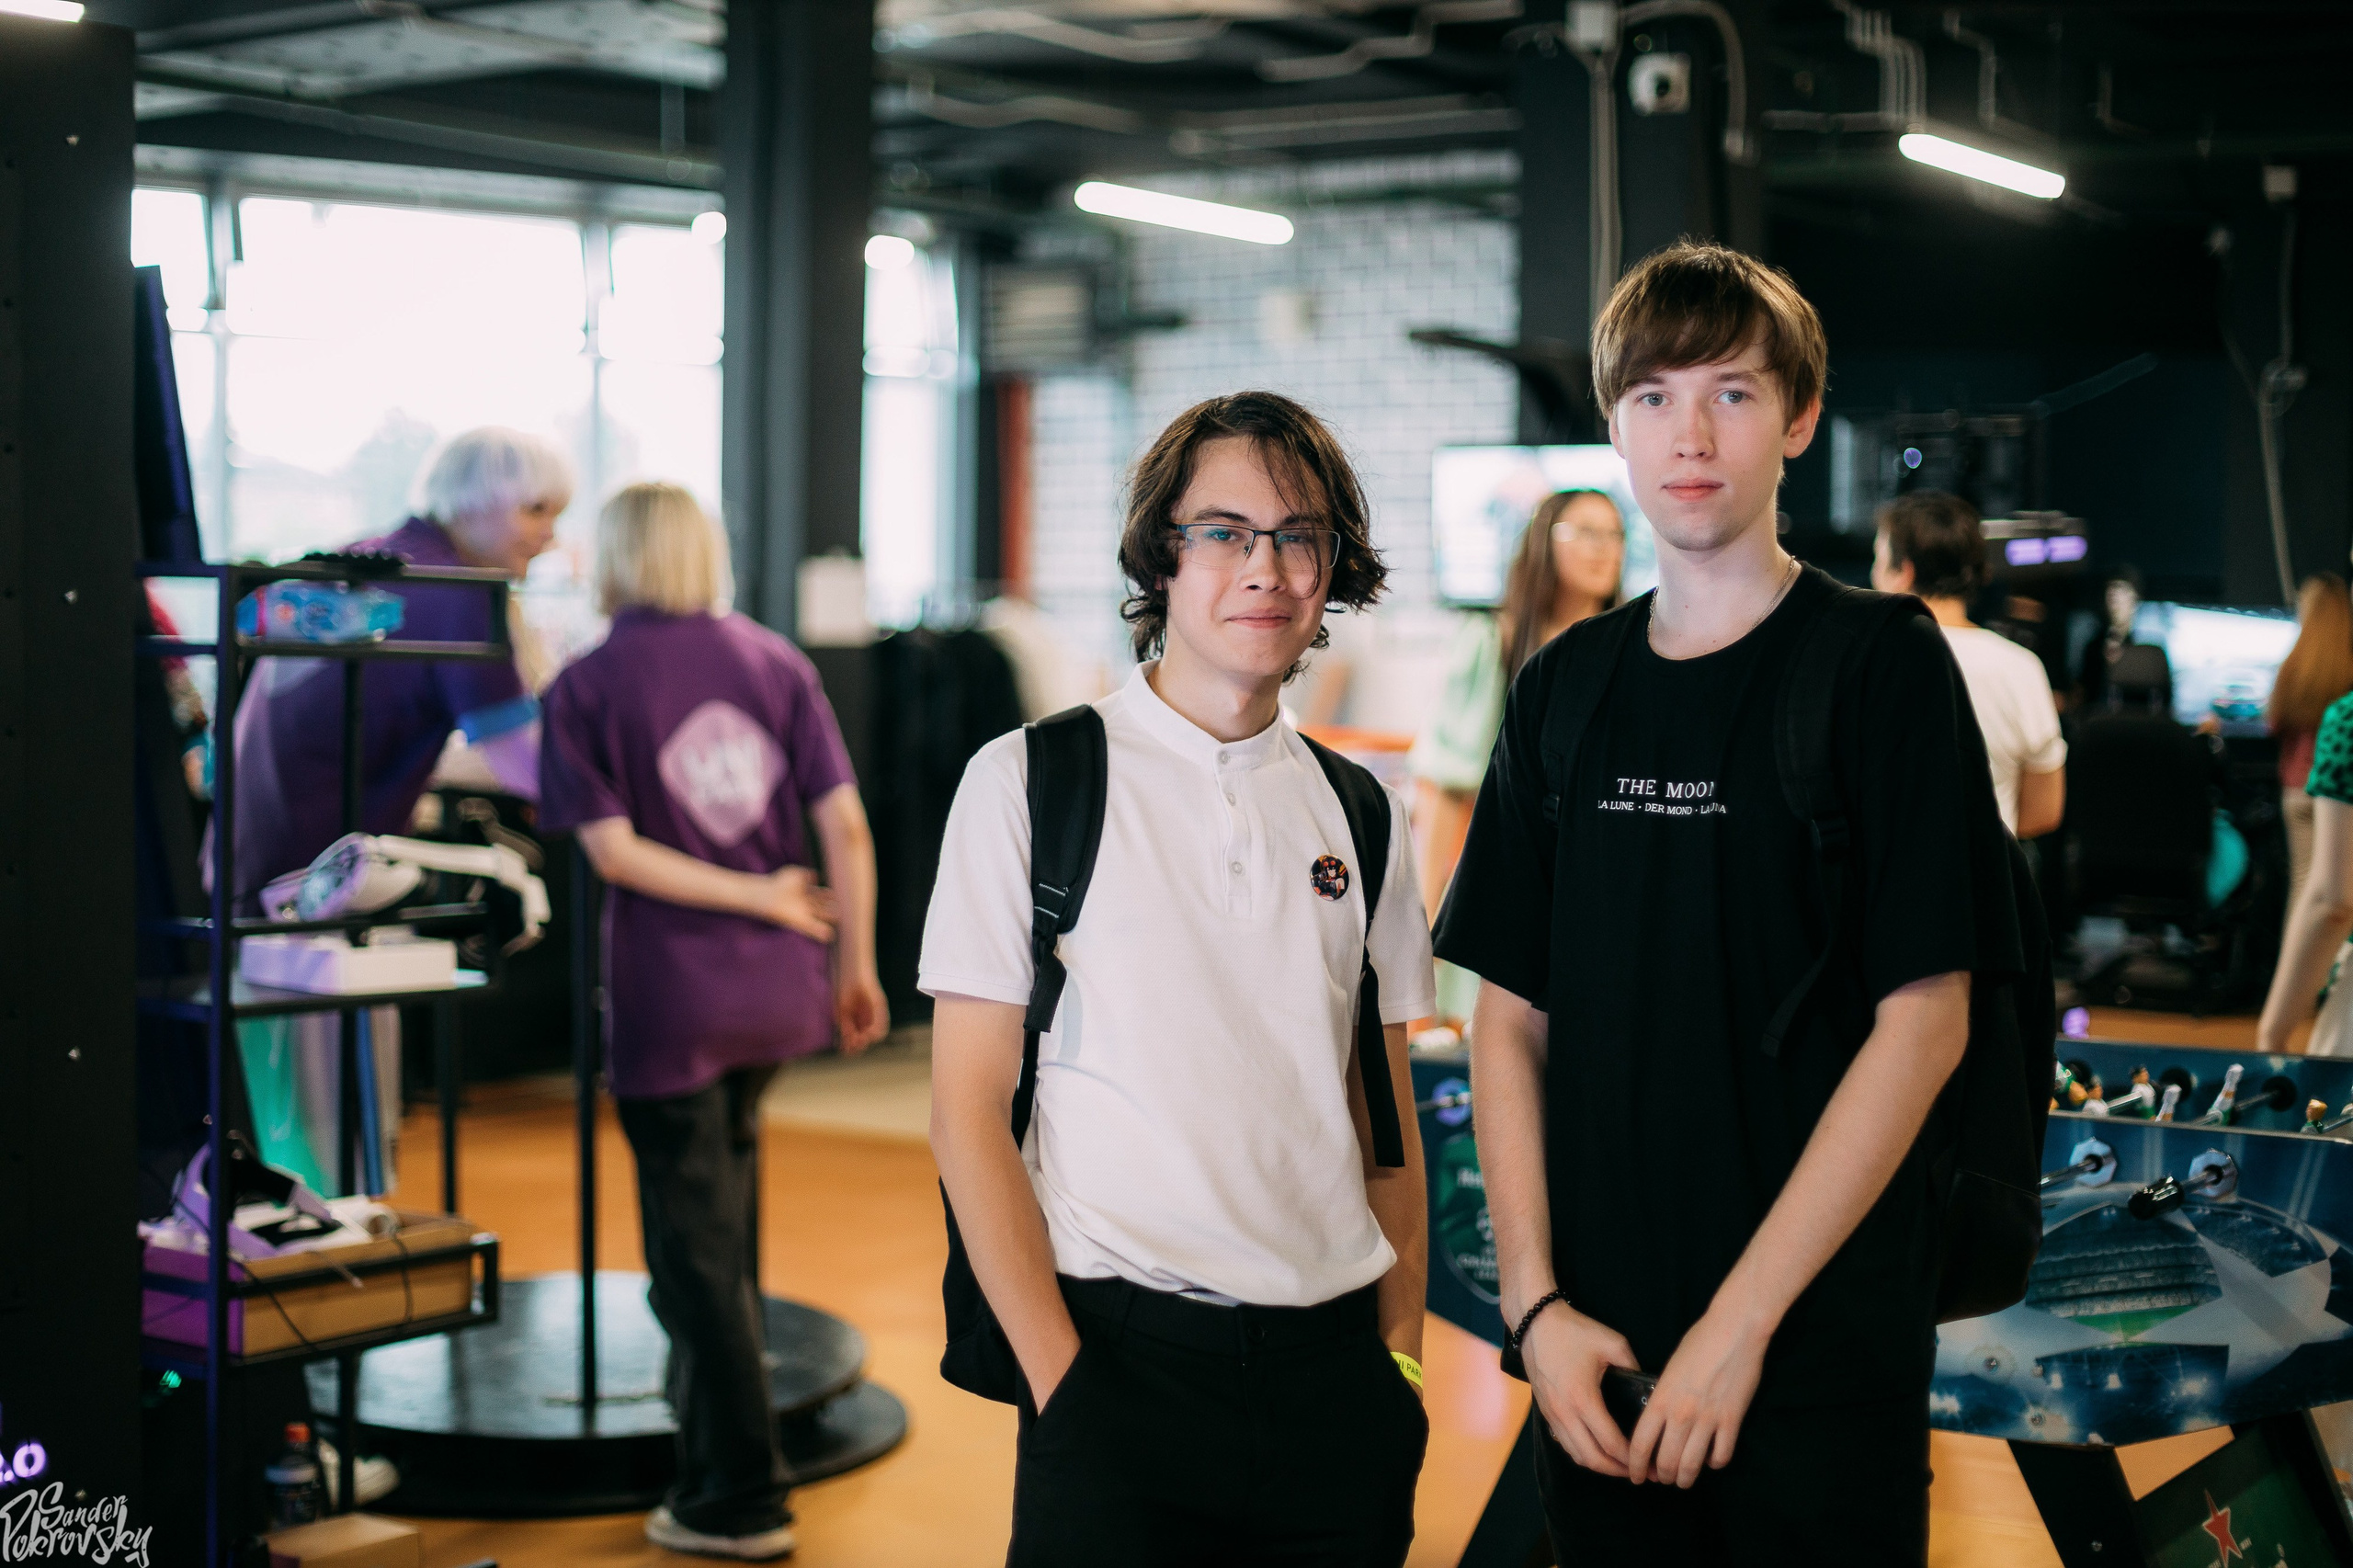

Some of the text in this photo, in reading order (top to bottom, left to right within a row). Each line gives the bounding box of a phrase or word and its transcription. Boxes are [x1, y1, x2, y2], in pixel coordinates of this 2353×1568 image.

[1617, 778, 1656, 795] THE
[1597, 800, 1608, 809] LA
[1609, 801, 1635, 811] LUNE
[1644, 802, 1665, 813] DER
[1666, 805, 1693, 815] MOND
